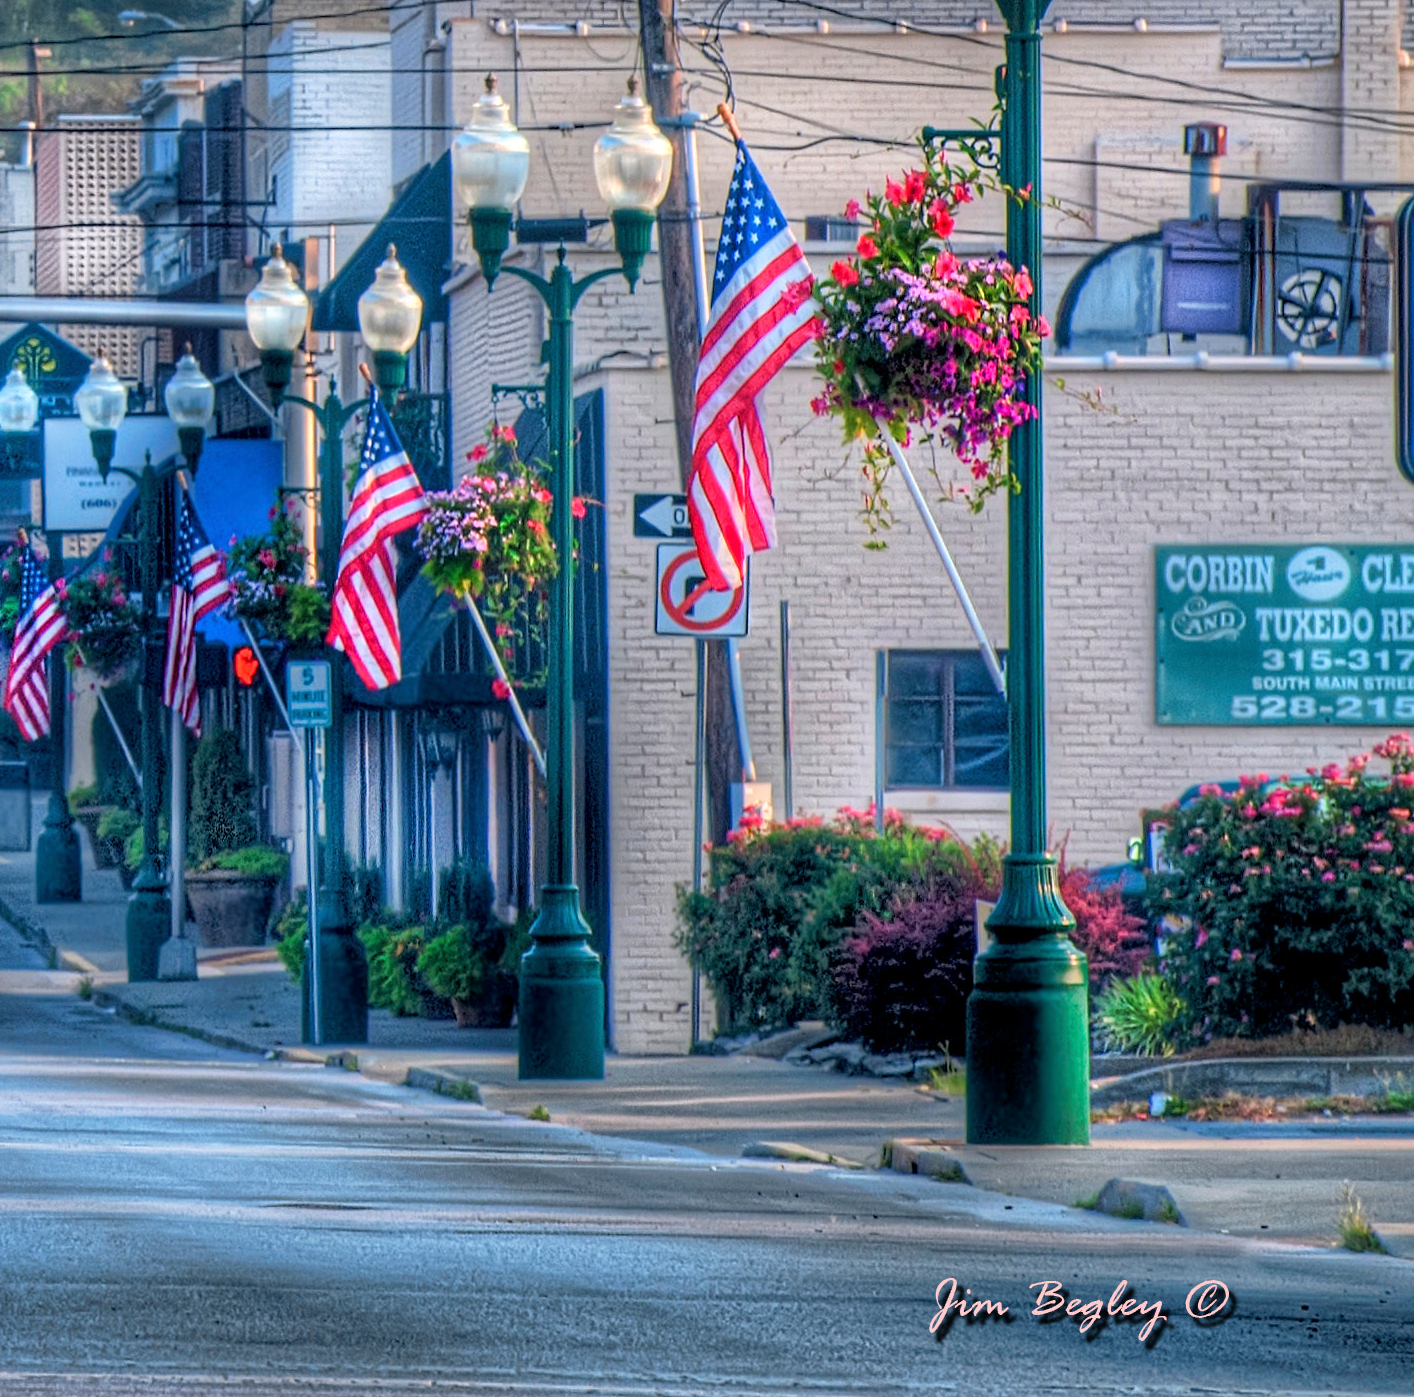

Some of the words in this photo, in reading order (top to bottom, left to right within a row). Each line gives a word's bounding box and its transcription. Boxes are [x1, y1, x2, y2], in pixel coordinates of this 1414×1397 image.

[1165, 554, 1275, 594] CORBIN
[1183, 610, 1236, 637] AND
[1255, 607, 1374, 643] TUXEDO
[302, 667, 315, 686] 5
[1252, 675, 1311, 691] SOUTH
[1315, 676, 1359, 691] MAIN
